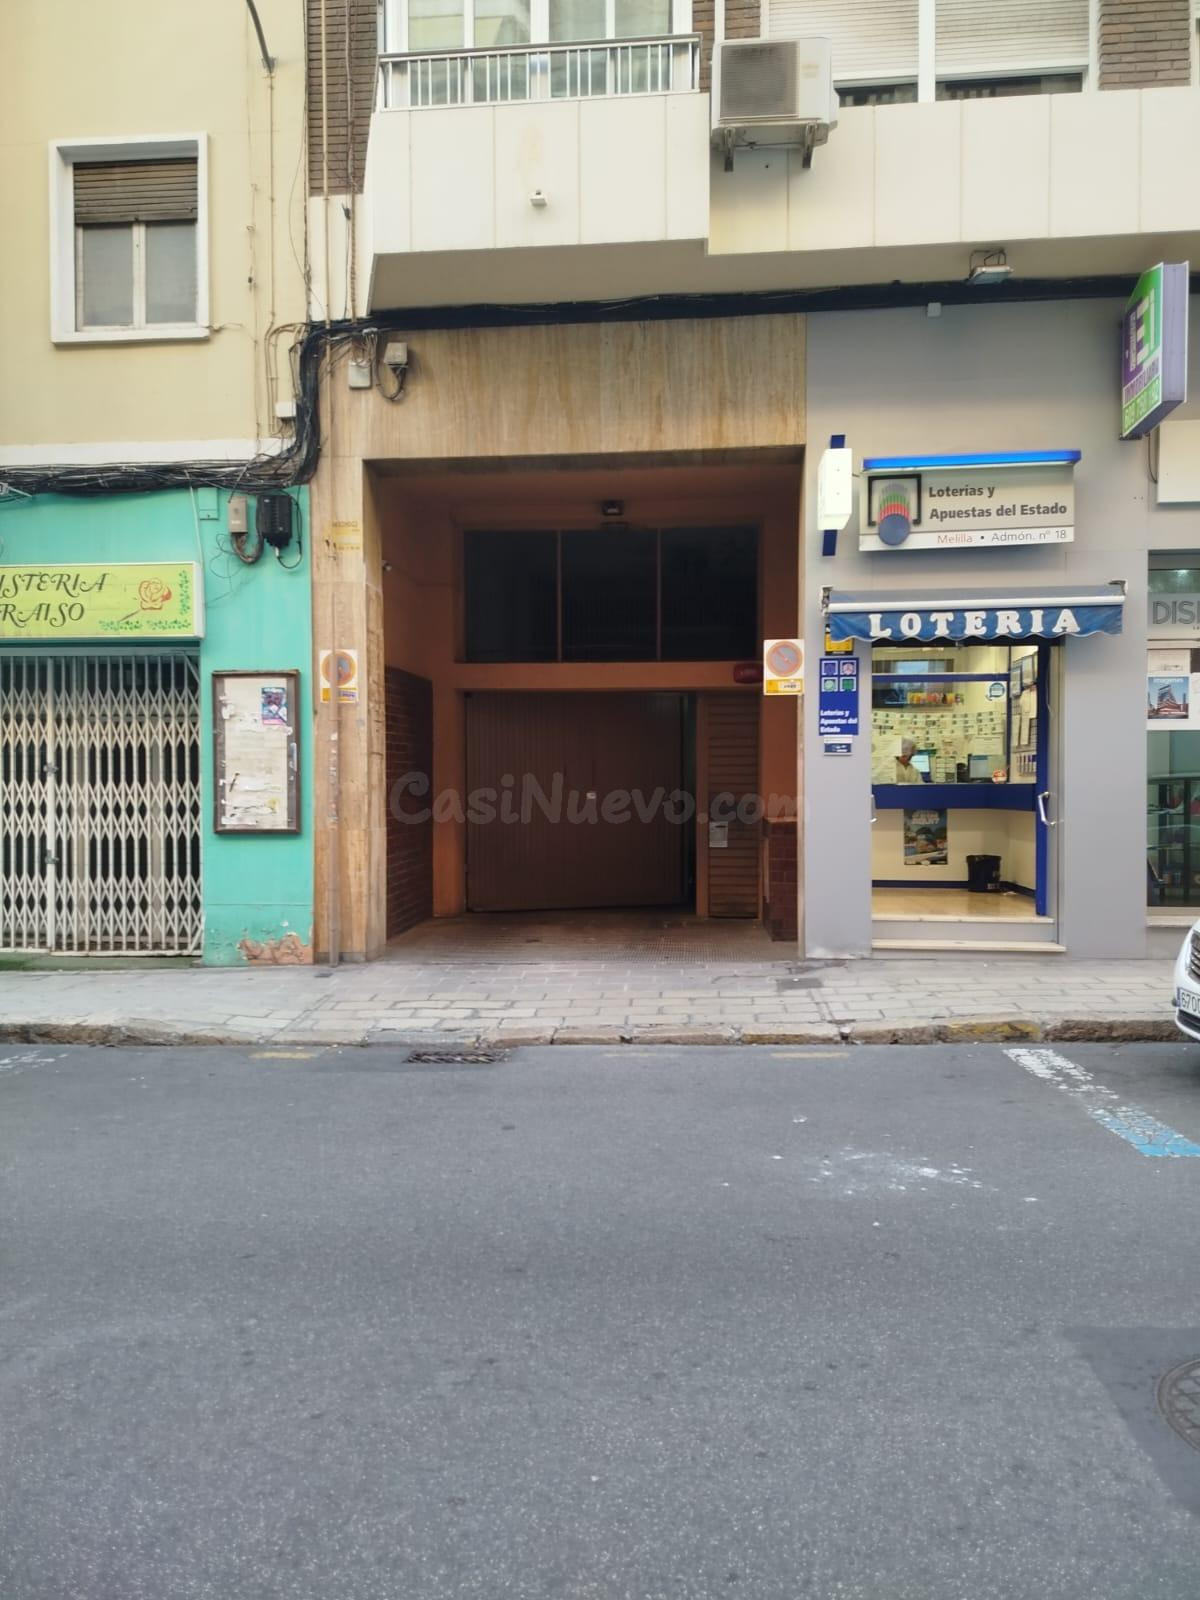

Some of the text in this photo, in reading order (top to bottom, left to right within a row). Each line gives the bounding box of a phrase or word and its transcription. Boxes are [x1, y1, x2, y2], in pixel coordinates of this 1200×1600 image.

[987, 486, 996, 498] y
[929, 502, 1067, 522] Apuestas del Estado
[937, 533, 973, 544] Melilla
[1056, 529, 1066, 539] 18
[1152, 600, 1200, 625] DIS
[868, 609, 1080, 637] LOTERIA
